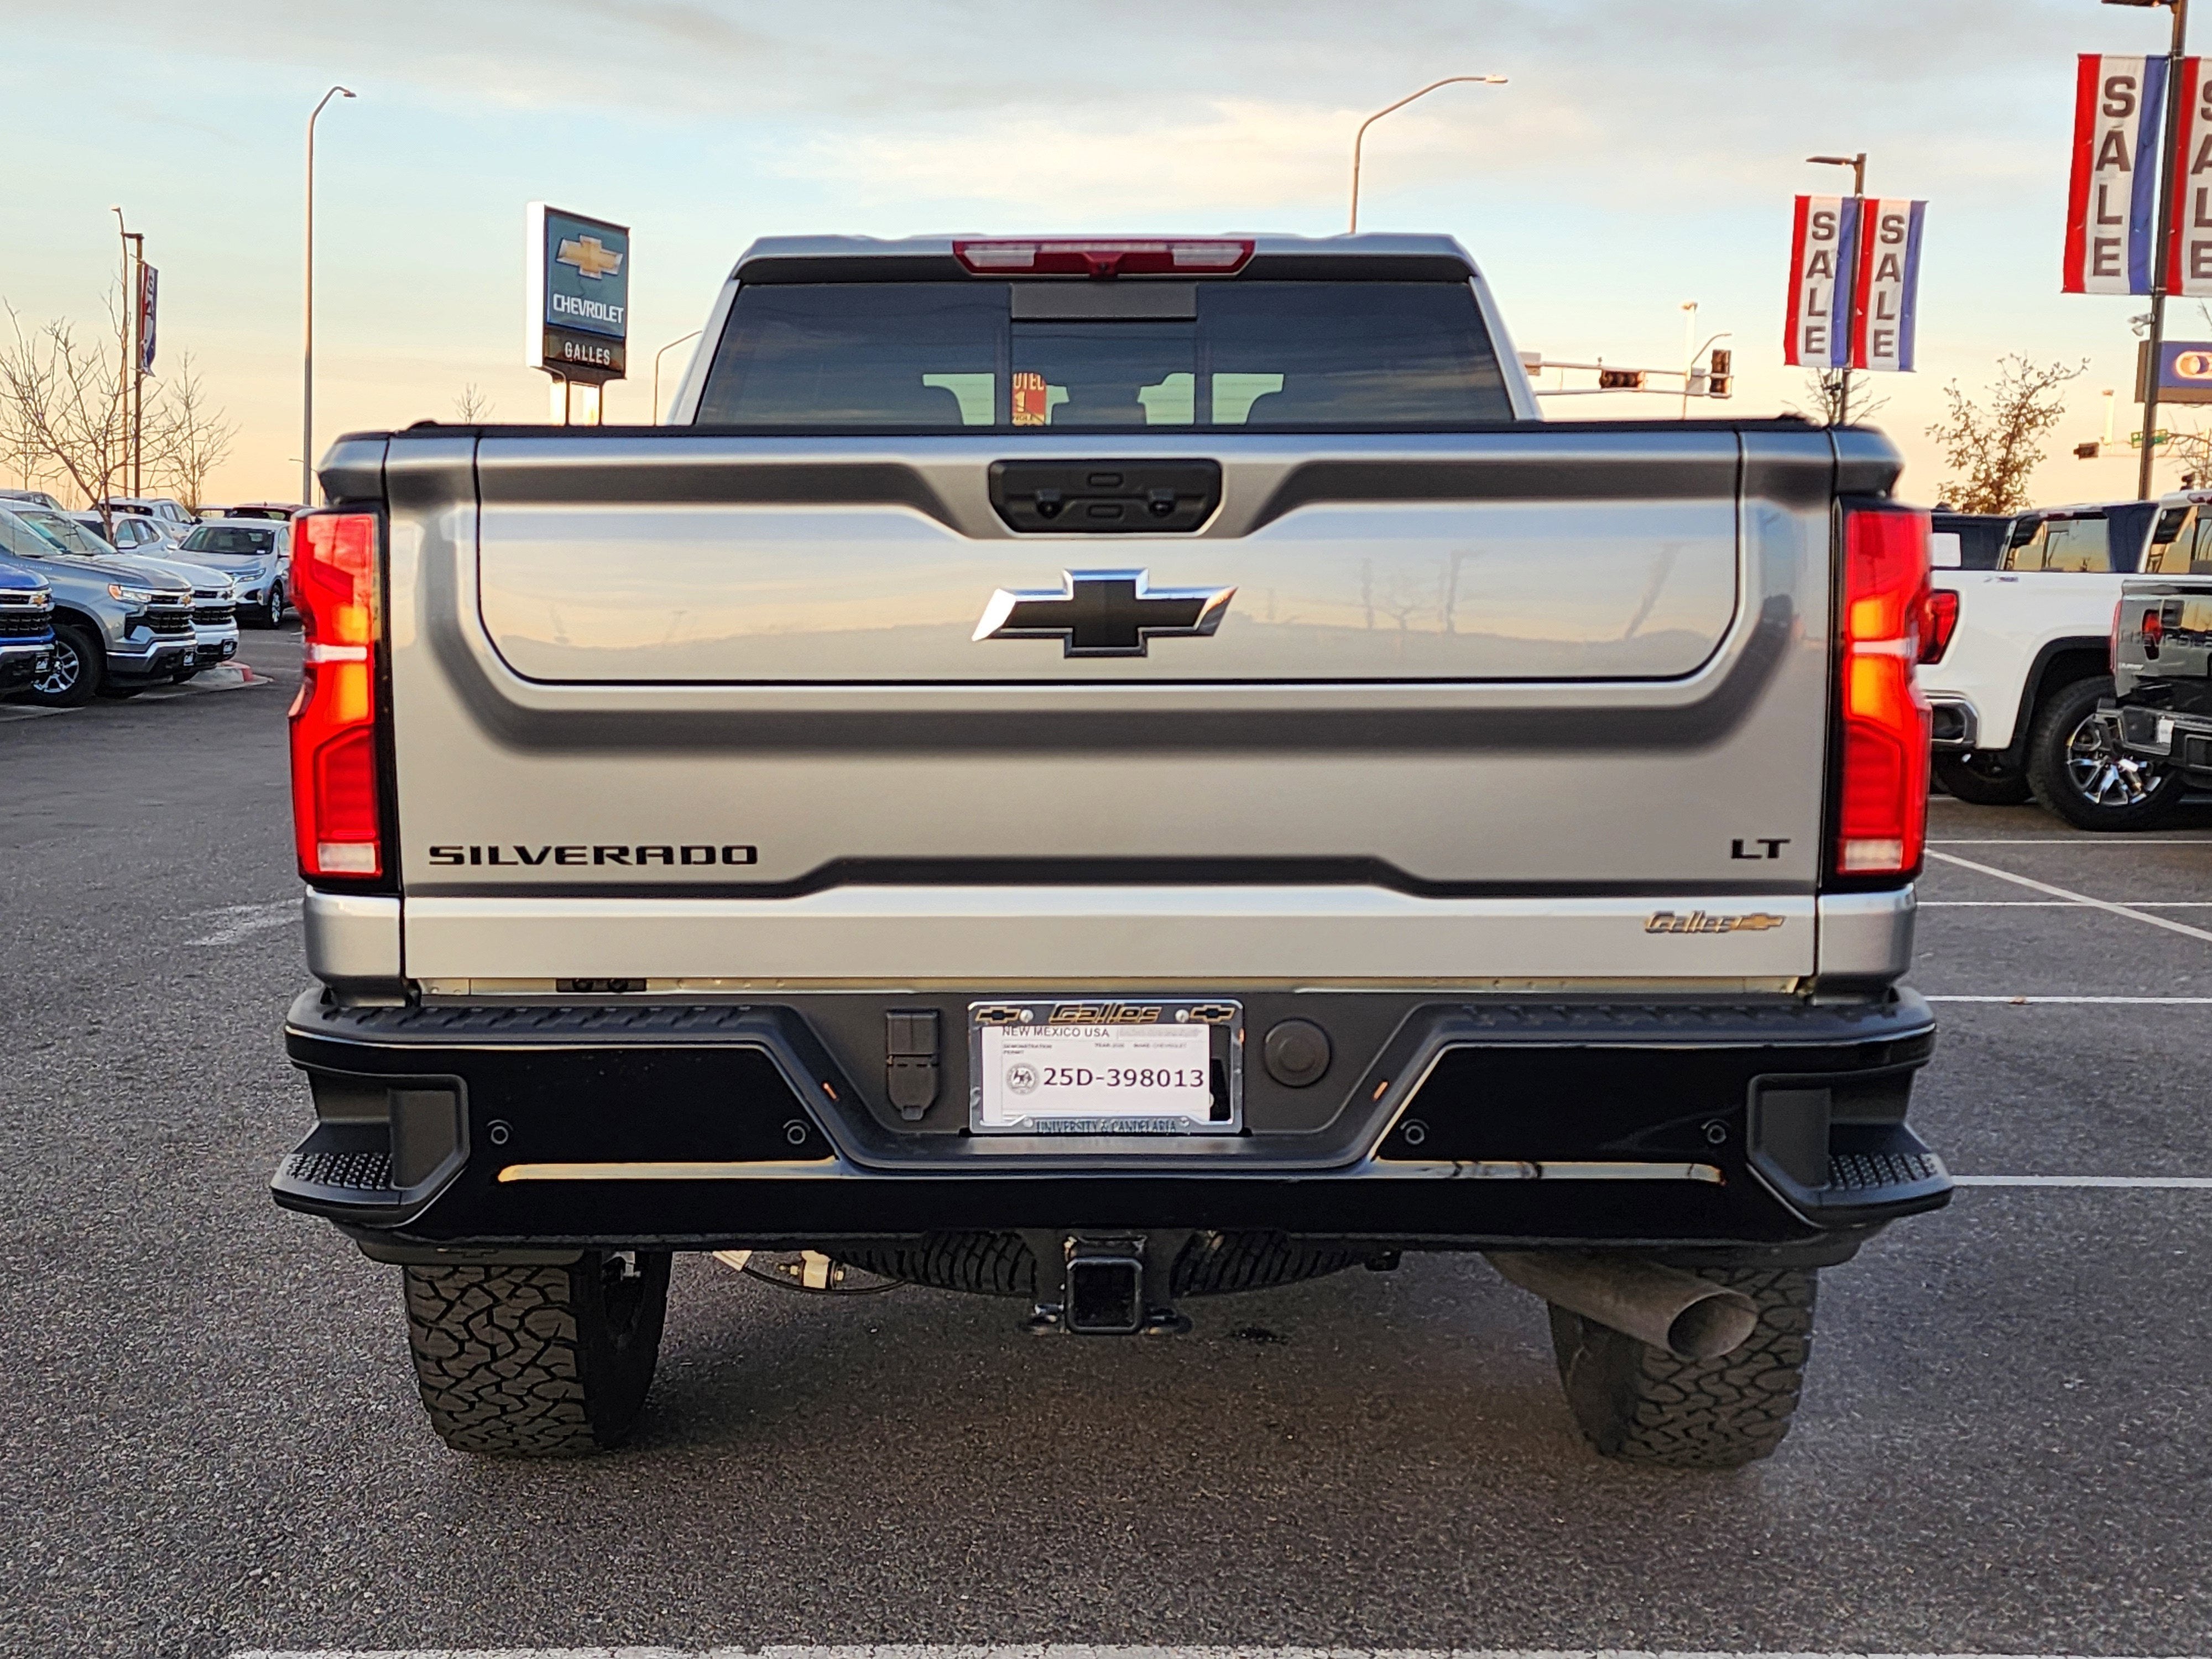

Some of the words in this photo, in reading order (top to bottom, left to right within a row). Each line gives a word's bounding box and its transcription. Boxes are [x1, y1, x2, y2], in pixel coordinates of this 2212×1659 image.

[2093, 75, 2137, 278] SALE
[1805, 211, 1837, 354] SALE
[1874, 214, 1905, 357] SALE
[553, 293, 624, 324] CHEVROLET
[565, 342, 611, 366] GALLES
[429, 846, 758, 865] SILVERADO
[1731, 838, 1791, 859] LT
[1048, 1003, 1162, 1024] Galles
[1002, 1026, 1030, 1037] NEW
[1033, 1026, 1080, 1037] MEXICO
[1084, 1027, 1110, 1037] USA
[1044, 1068, 1204, 1087] 25D-398013
[1036, 1120, 1097, 1133] UNIVERSITY
